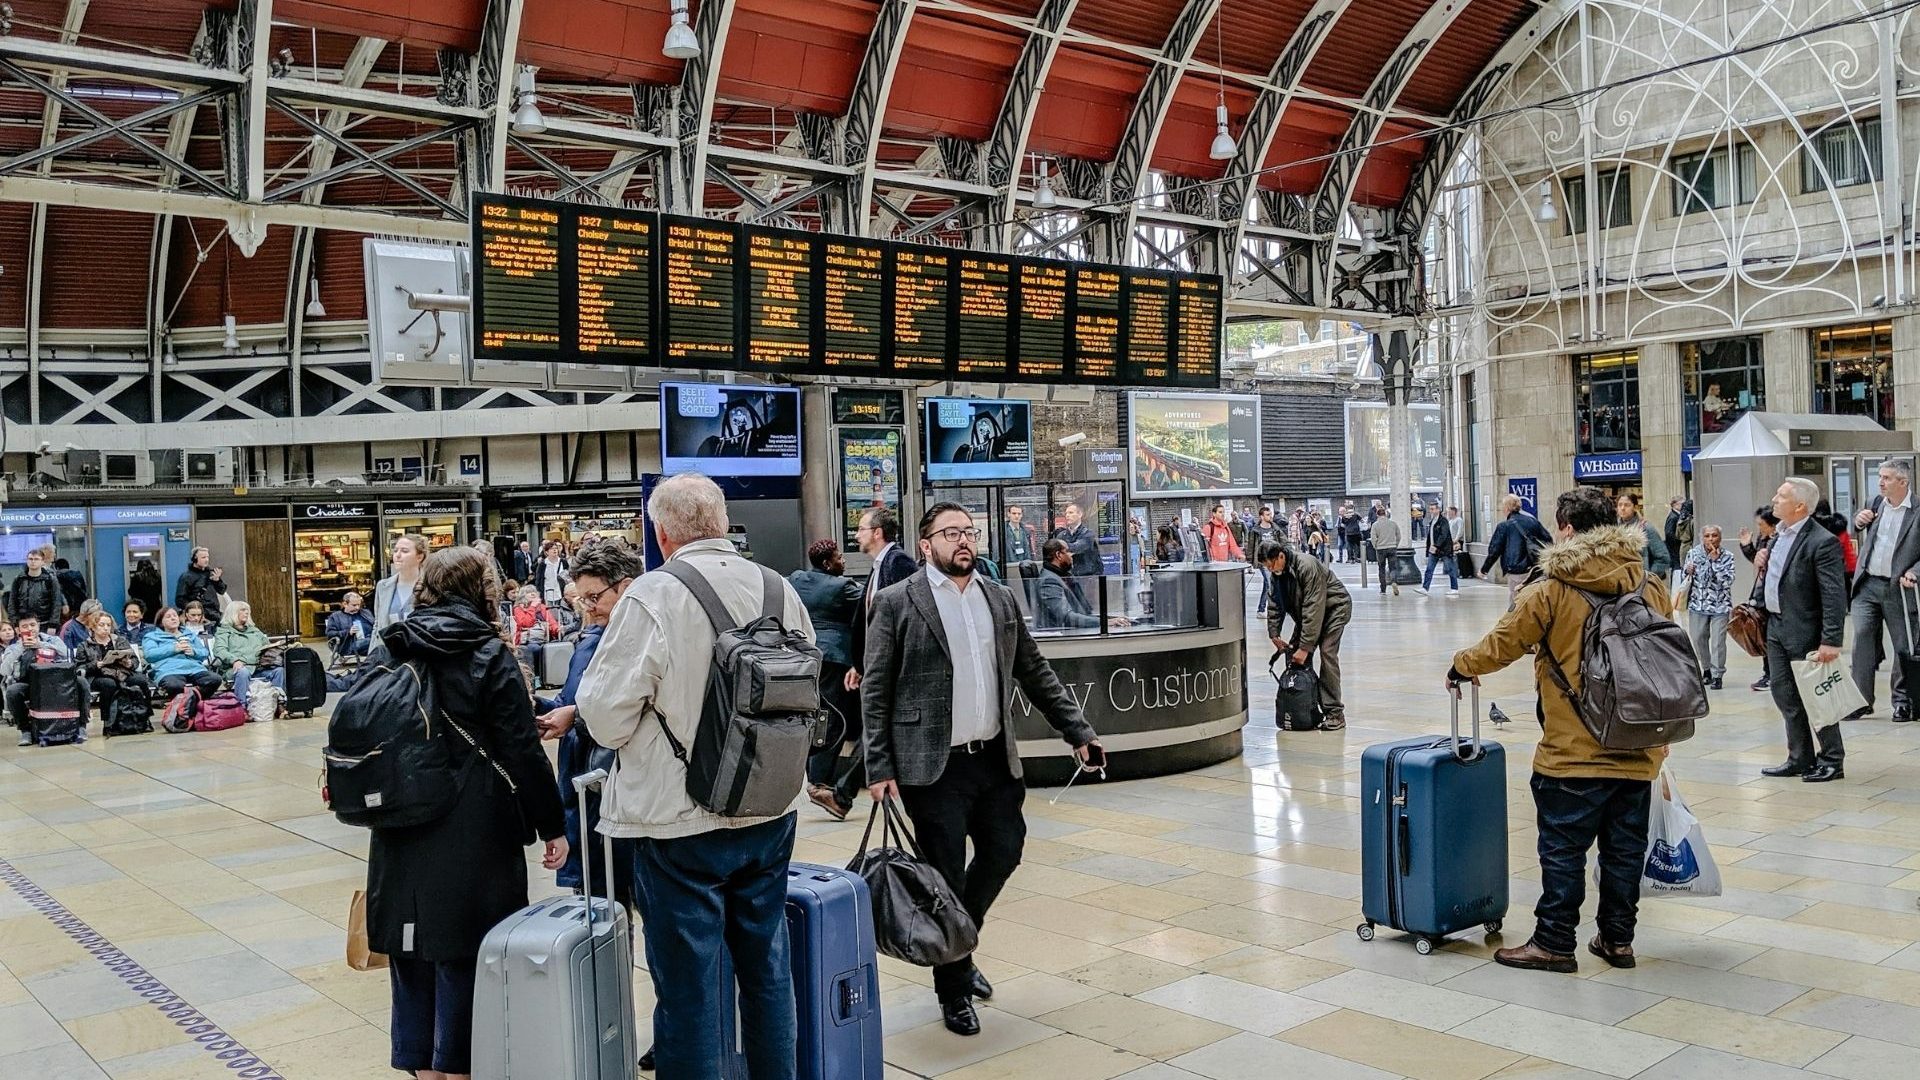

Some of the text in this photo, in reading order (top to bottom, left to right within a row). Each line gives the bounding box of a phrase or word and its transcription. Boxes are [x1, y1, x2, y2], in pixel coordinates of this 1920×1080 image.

[484, 206, 558, 223] 13:22 Boarding
[482, 221, 517, 230] Worcester
[579, 216, 648, 233] 13:27 Boarding
[578, 229, 608, 241] Cholsey
[669, 227, 733, 242] 13:30 Preparing
[486, 243, 556, 255] platform, passengers
[669, 238, 727, 252] Bristol T Meads
[751, 237, 810, 251] 13:33 Pls wait
[500, 252, 533, 261] Charlbury
[578, 251, 629, 262] Ealing Broadway
[751, 248, 783, 259] Heathrow
[857, 248, 867, 257] Pls
[869, 250, 881, 258] wait
[897, 252, 914, 261] 13:42
[935, 257, 947, 265] wait
[491, 259, 511, 267] board
[578, 259, 597, 267] Hayes
[606, 262, 638, 270] Harlington
[826, 256, 875, 269] Cheltenham Spa
[897, 263, 921, 273] Twyford
[962, 260, 977, 269] 13:45
[998, 264, 1008, 272] wait
[1022, 266, 1037, 274] 13:47
[1098, 272, 1119, 282] Boarding
[1077, 280, 1119, 291] Heathrow Airport
[579, 298, 614, 306] Maidenhead
[1097, 317, 1118, 326] Boarding
[579, 329, 615, 337] Pangbourne
[1076, 325, 1117, 334] Heathrow Airport
[681, 388, 697, 396] SEE
[681, 396, 696, 404] SAY
[681, 406, 715, 414] SORTED
[846, 446, 895, 459] escape
[1091, 452, 1122, 463] Paddington
[378, 462, 392, 473] 12
[463, 459, 477, 470] 14
[1098, 464, 1118, 474] Station
[1578, 458, 1638, 473] WHSmith
[0, 513, 34, 522] URRENCY
[1651, 856, 1684, 872] Together
[1651, 882, 1667, 891] Join
